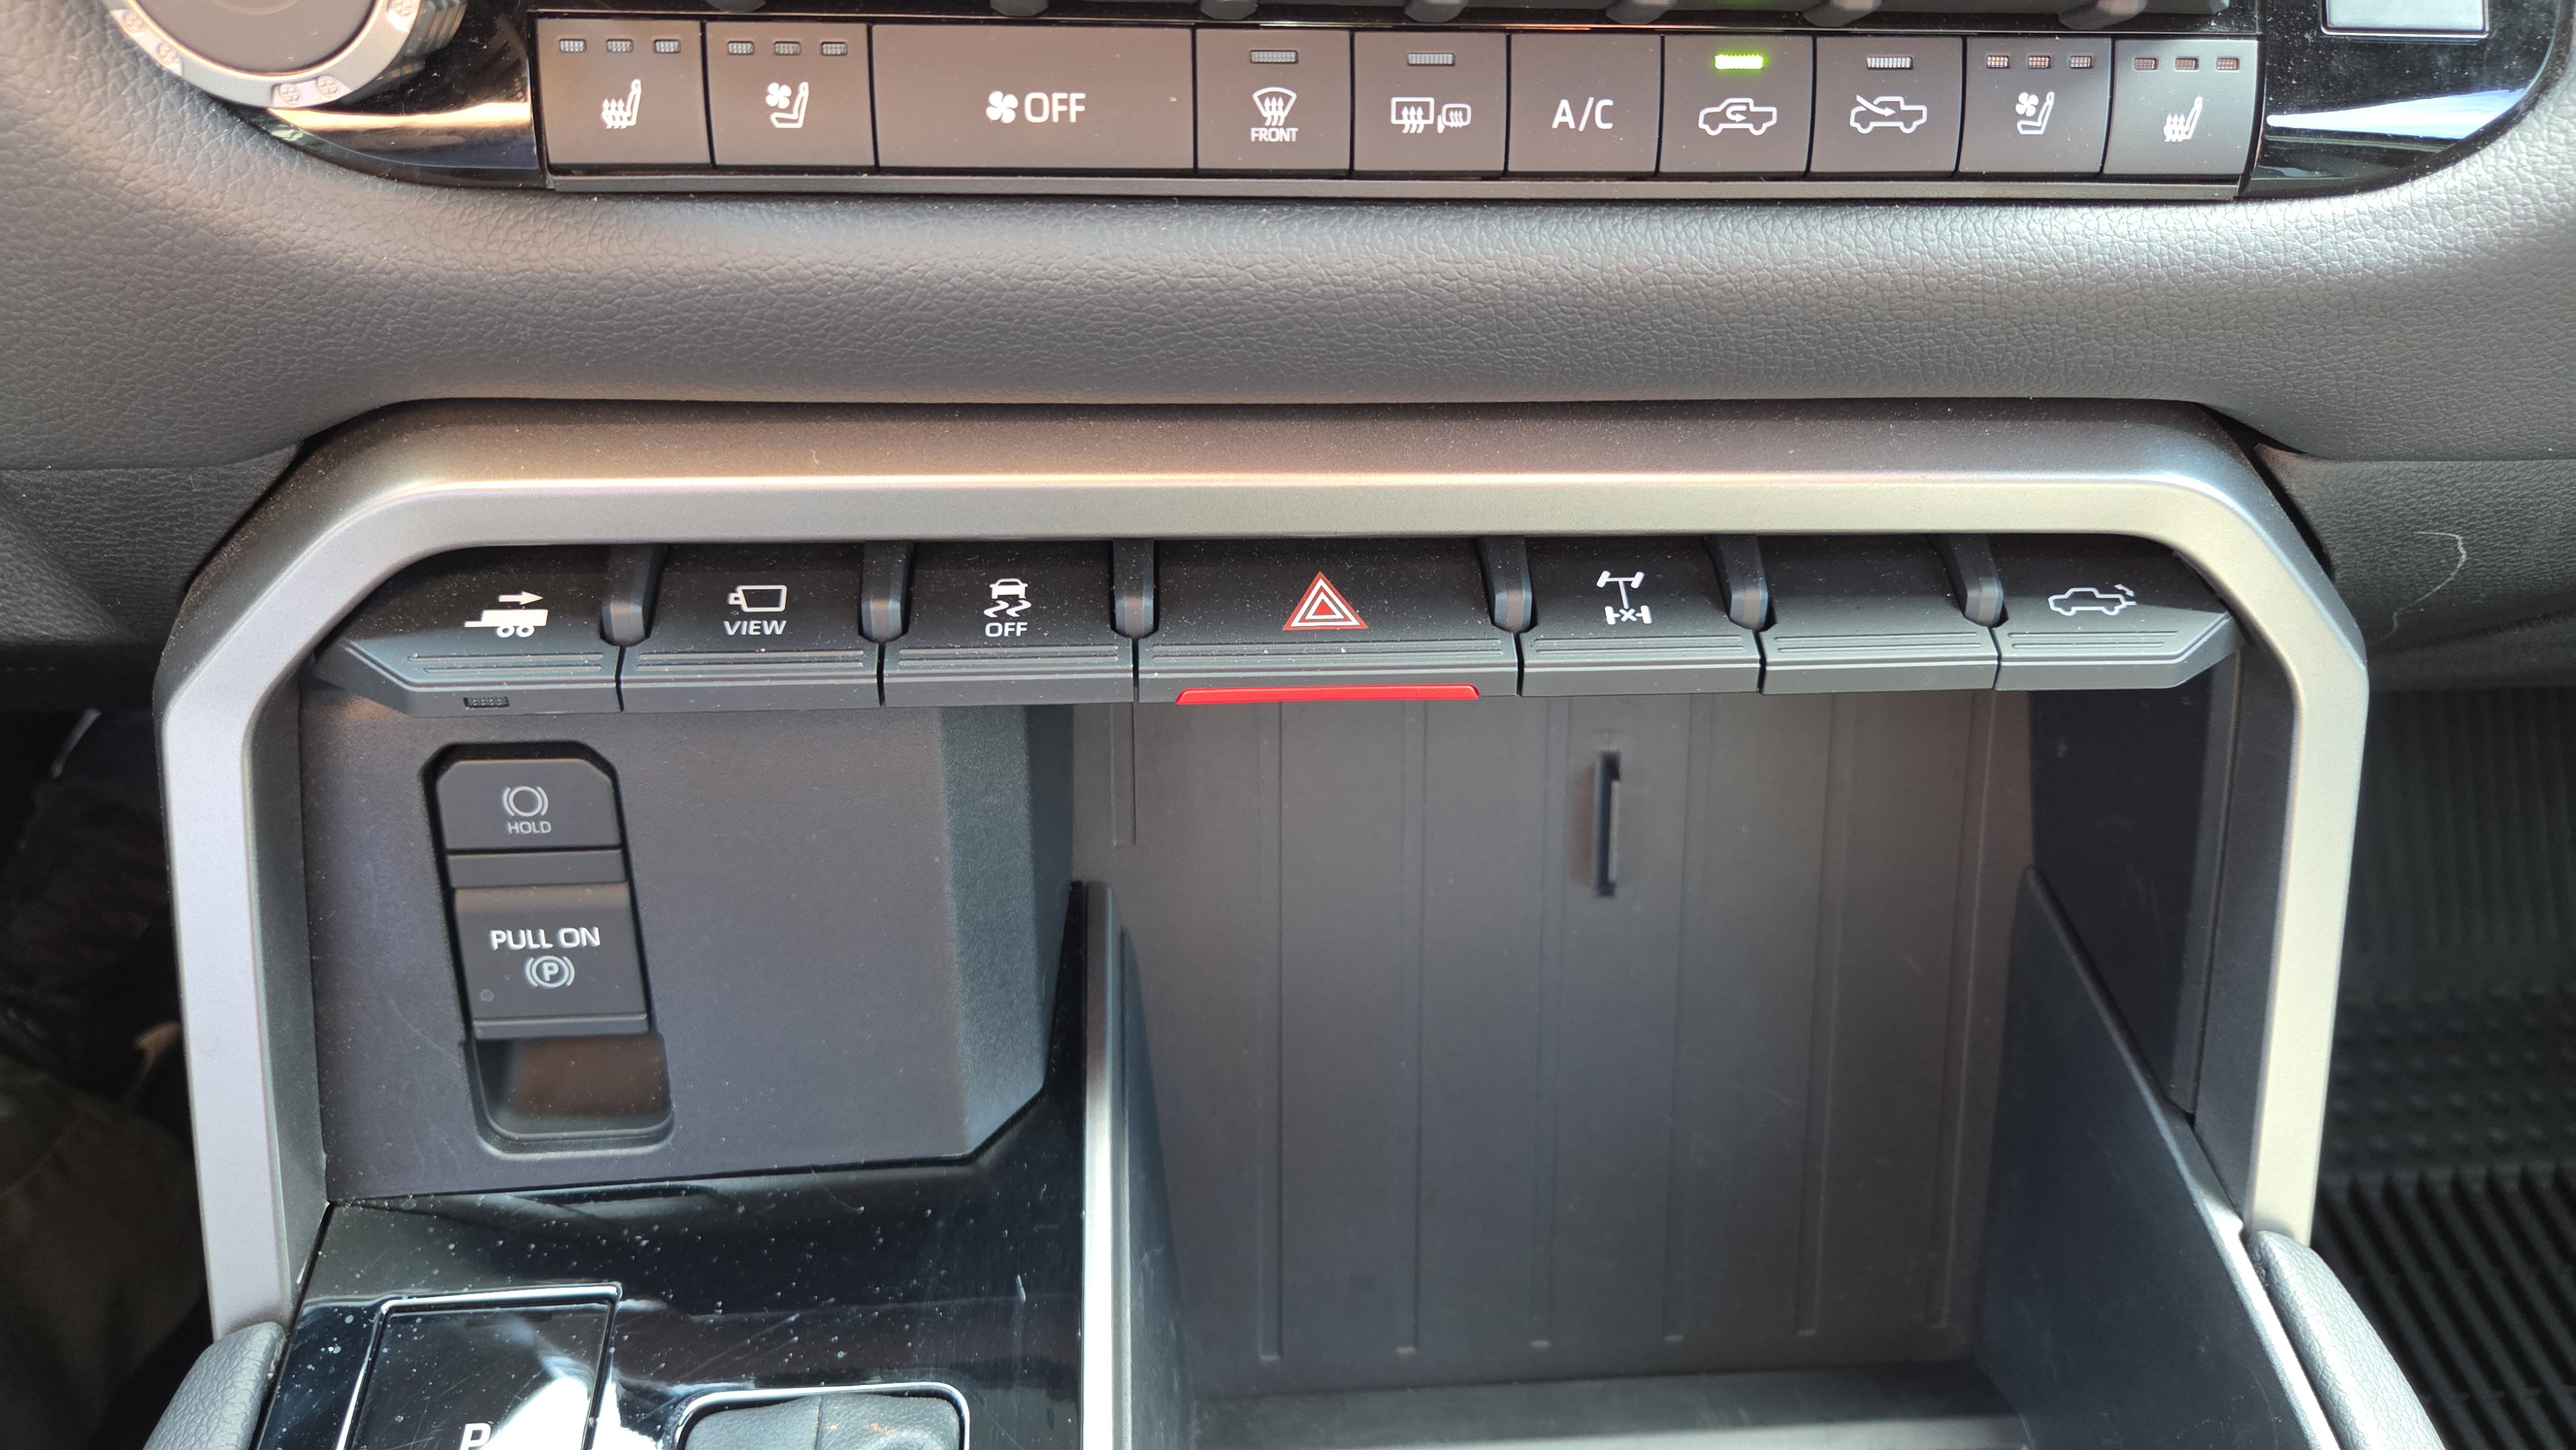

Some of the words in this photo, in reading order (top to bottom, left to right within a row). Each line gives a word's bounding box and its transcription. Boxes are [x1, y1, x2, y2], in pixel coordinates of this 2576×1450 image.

[1023, 91, 1086, 124] OFF
[1552, 97, 1615, 131] A/C
[1250, 127, 1298, 142] FRONT
[723, 619, 788, 636] VIEW
[985, 621, 1028, 637] OFF
[507, 821, 552, 834] HOLD
[489, 928, 553, 951] PULL
[559, 927, 601, 948] ON
[543, 962, 559, 983] P
